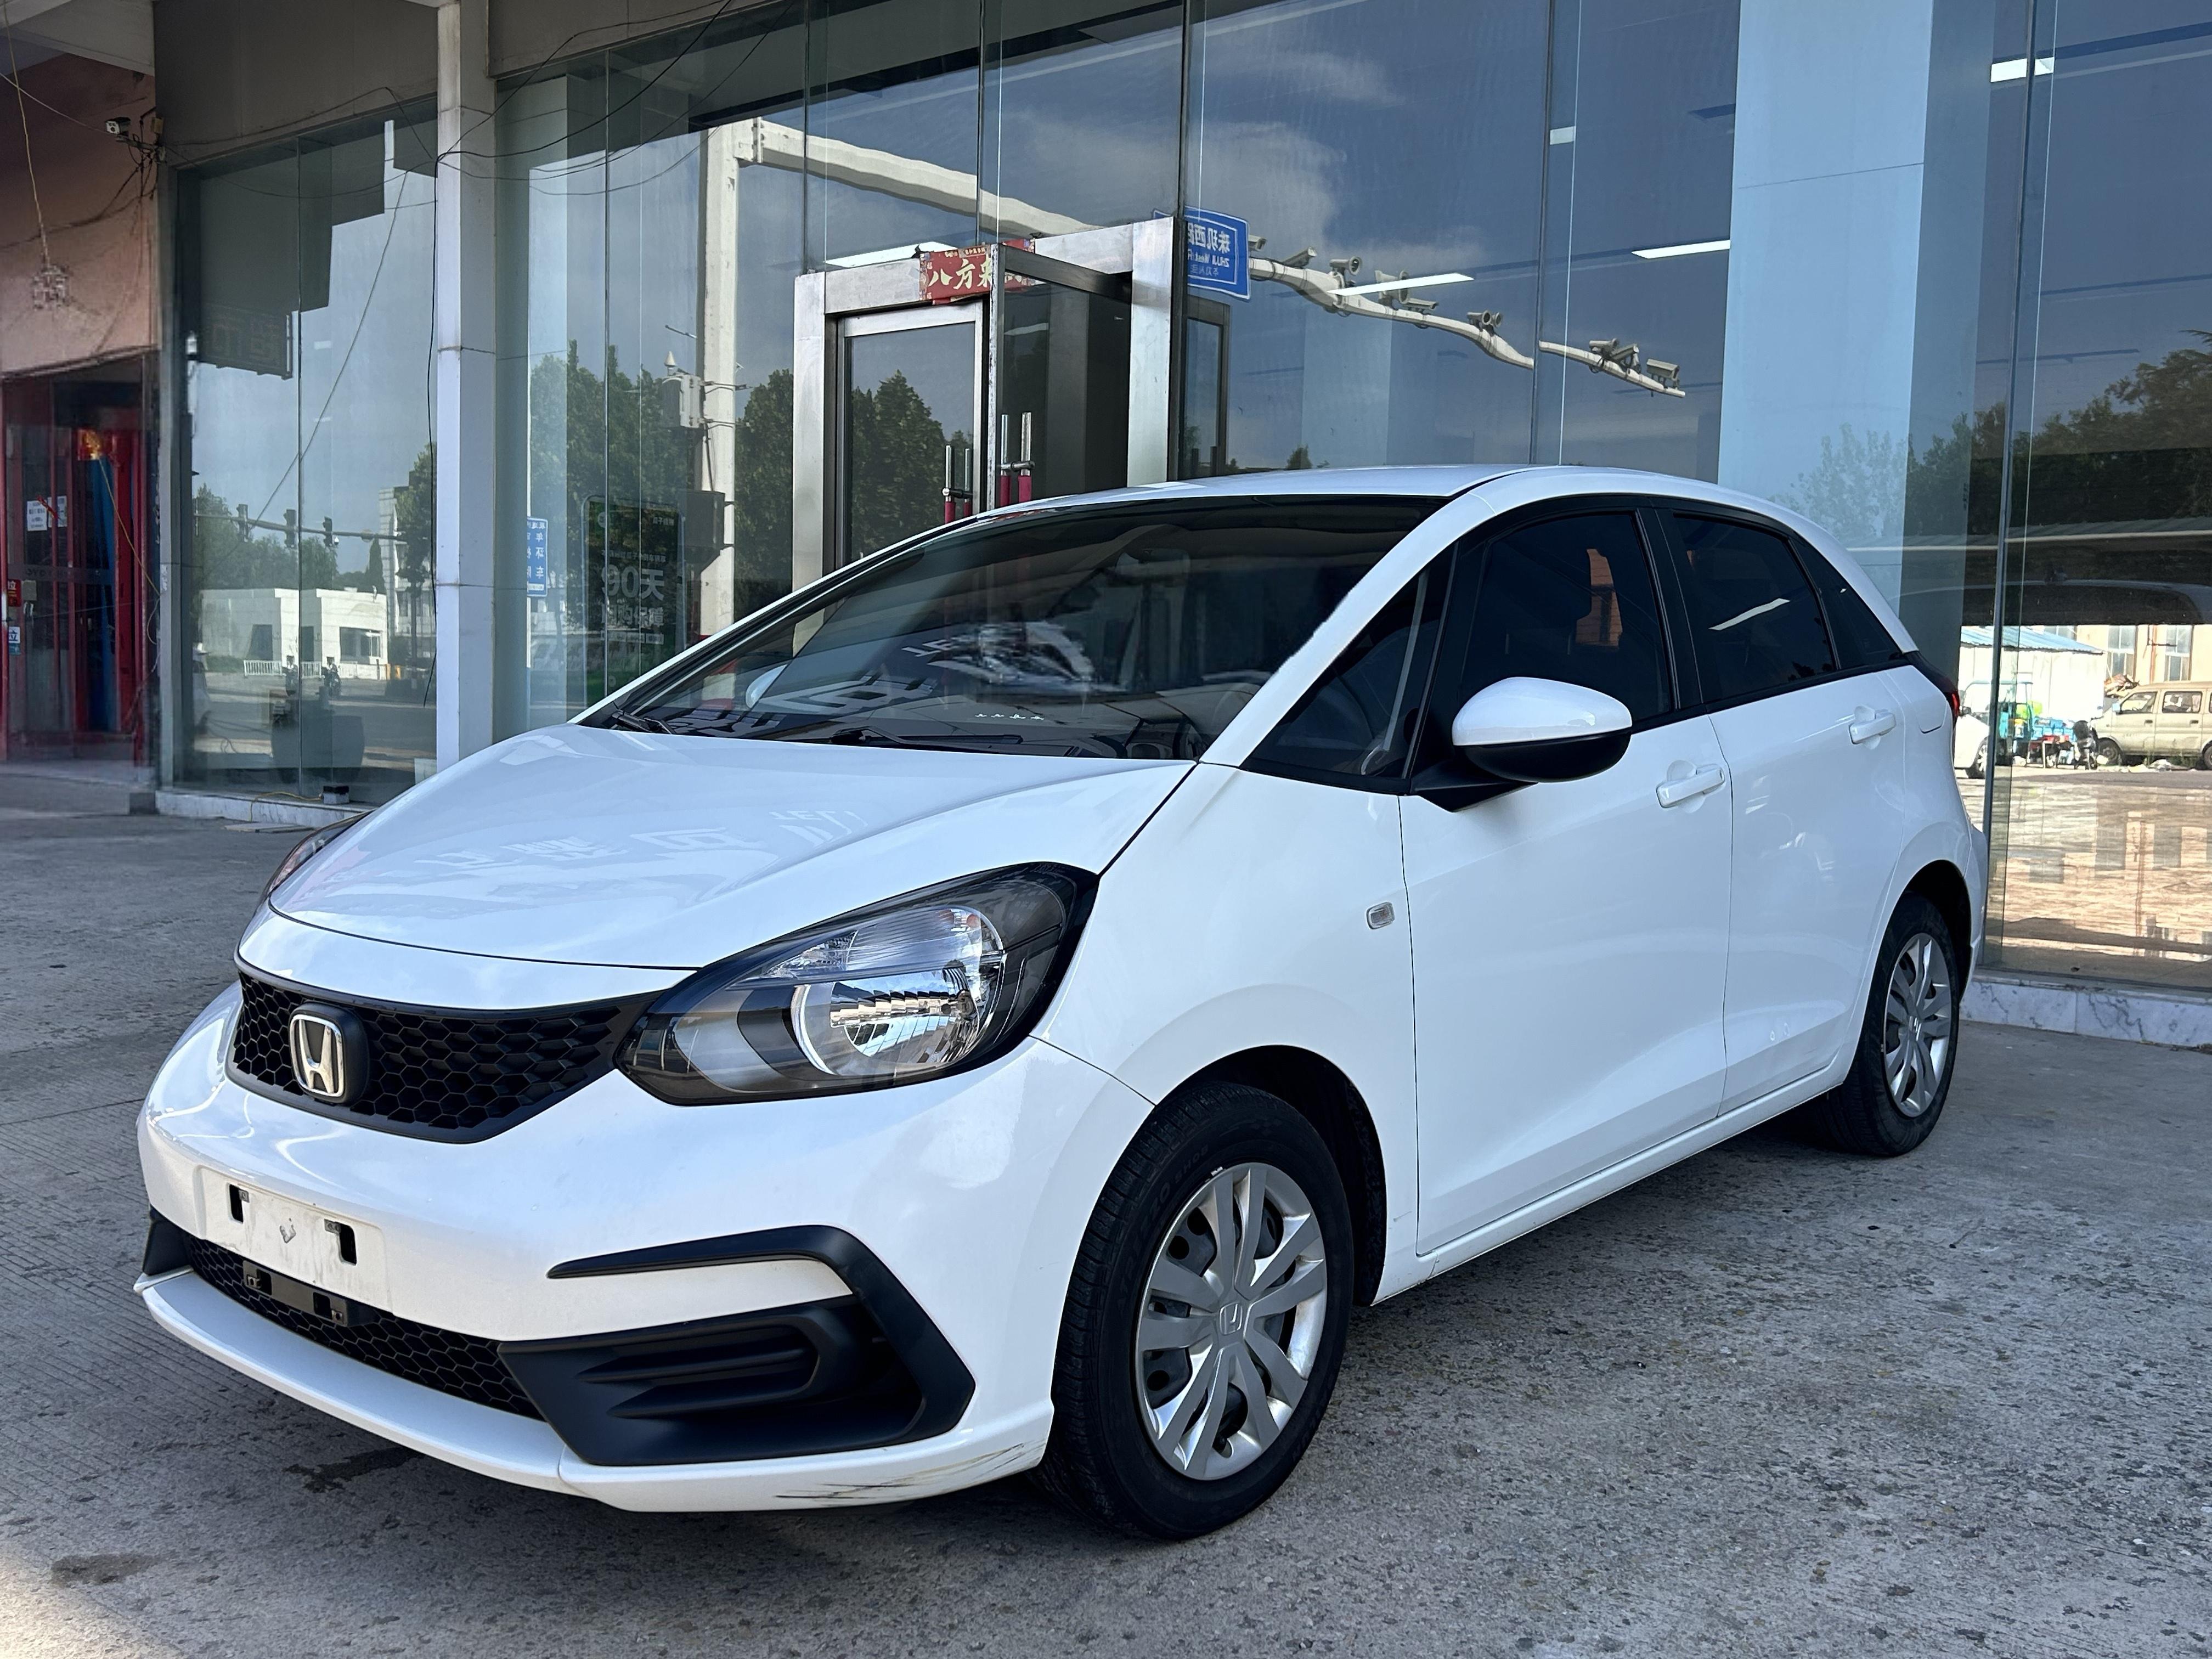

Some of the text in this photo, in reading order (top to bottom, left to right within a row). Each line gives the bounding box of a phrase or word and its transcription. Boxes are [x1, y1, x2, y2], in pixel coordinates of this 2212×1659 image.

[928, 252, 1022, 290] 八方来
[601, 564, 665, 601] 90天
